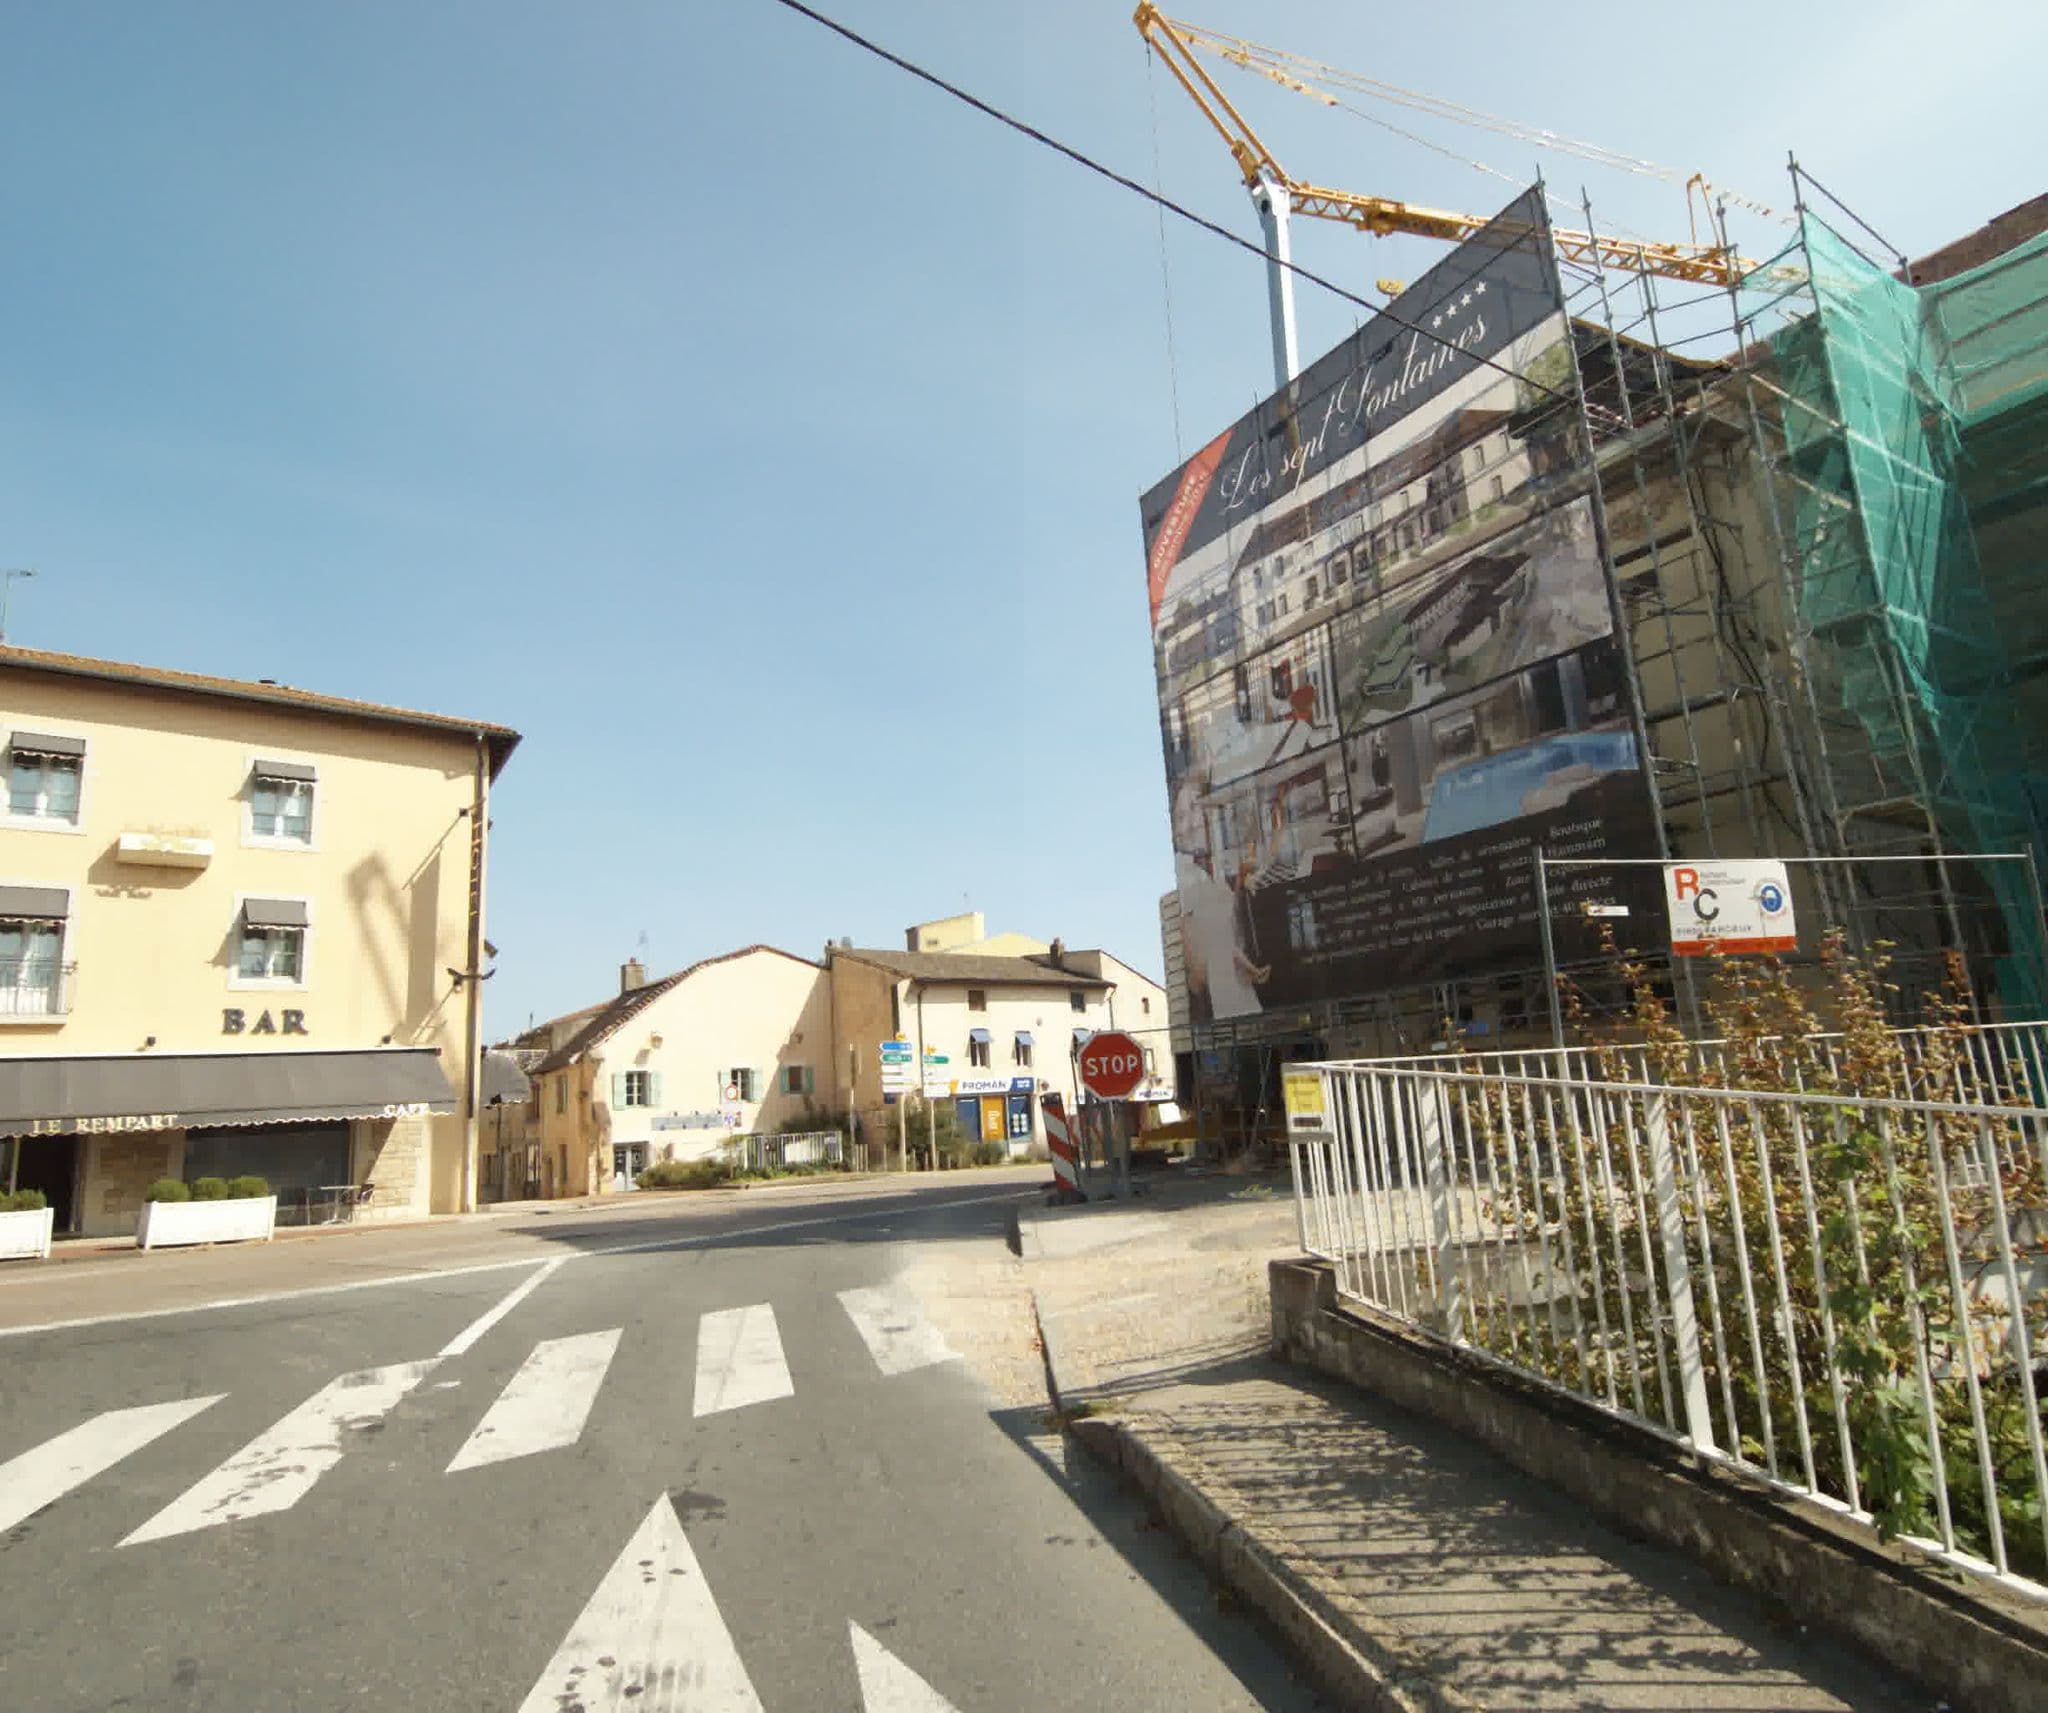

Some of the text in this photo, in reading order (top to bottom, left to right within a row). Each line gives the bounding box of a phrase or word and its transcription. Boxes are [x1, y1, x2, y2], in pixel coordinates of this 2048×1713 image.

[1220, 313, 1486, 512] Les sept Fontaines
[222, 1008, 309, 1036] BAR
[1085, 1054, 1139, 1076] STOP
[962, 1079, 1007, 1091] PROMAN
[31, 1114, 179, 1135] LE REMPART
